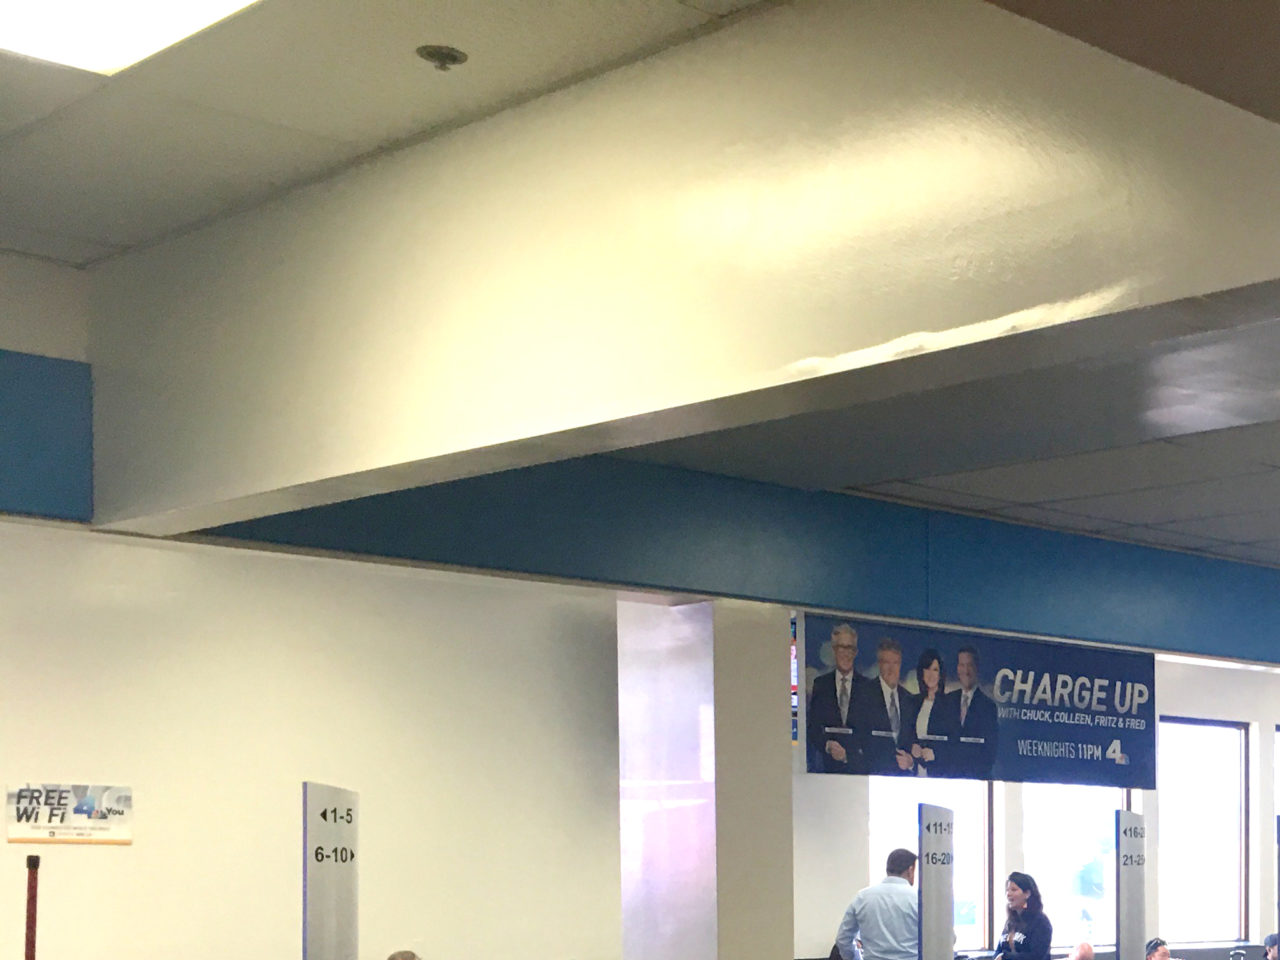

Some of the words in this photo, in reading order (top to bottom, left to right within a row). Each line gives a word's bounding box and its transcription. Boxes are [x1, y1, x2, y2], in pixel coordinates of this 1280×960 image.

[992, 667, 1109, 712] CHARGE
[1114, 681, 1149, 715] UP
[997, 706, 1021, 719] WITH
[1021, 708, 1052, 723] CHUCK,
[1054, 711, 1093, 727] COLLEEN,
[1095, 715, 1117, 727] FRITZ
[1118, 717, 1124, 728] &
[1125, 718, 1146, 730] FRED
[1017, 739, 1075, 759] WEEKNIGHTS
[1078, 743, 1102, 760] 11PM
[1105, 739, 1124, 764] 4
[16, 788, 71, 806] FREE
[16, 806, 40, 823] Wi
[48, 807, 67, 824] Fi
[106, 807, 125, 816] You
[330, 807, 353, 824] 1-5
[314, 846, 348, 863] 6-10
